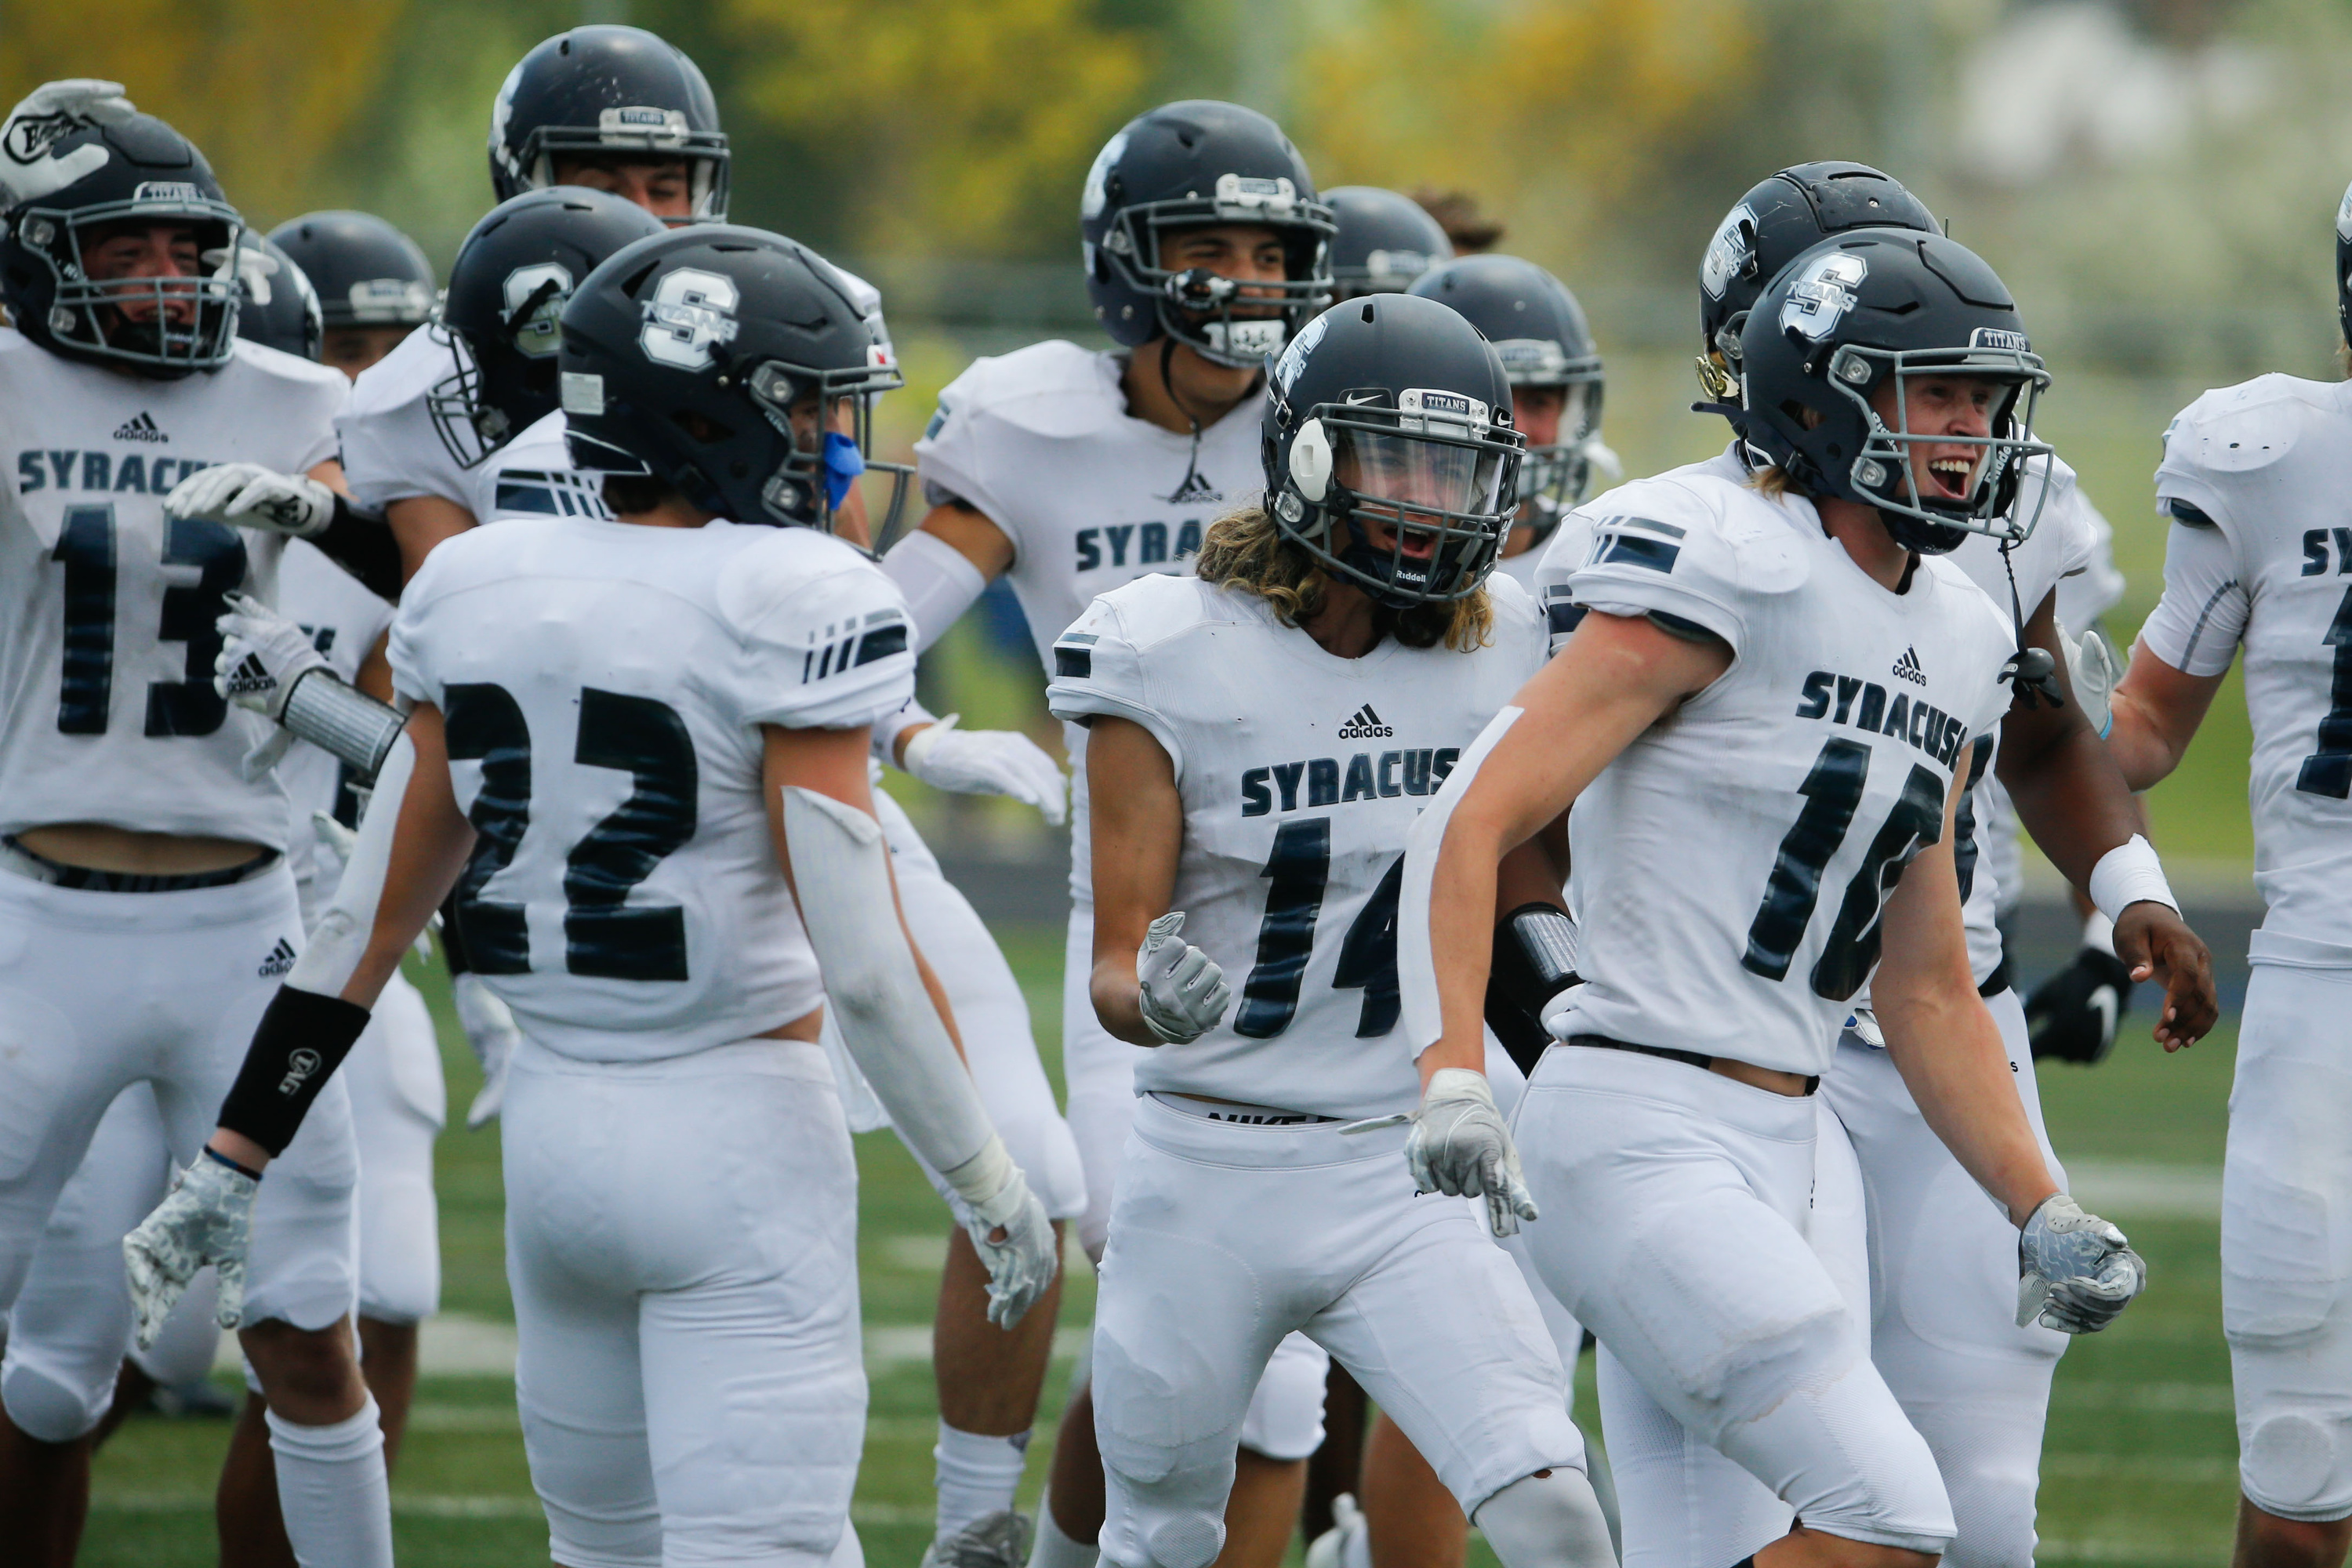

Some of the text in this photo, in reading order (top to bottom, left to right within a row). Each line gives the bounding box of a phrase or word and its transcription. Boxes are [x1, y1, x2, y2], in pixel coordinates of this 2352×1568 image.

[1984, 332, 2027, 351] TITANS
[1427, 395, 1466, 412] TITANS
[114, 430, 169, 443] adidas
[1396, 569, 1427, 583] Riddell
[51, 503, 247, 739] 13
[1893, 664, 1927, 687] adidas
[1338, 724, 1393, 739] adidas
[1241, 747, 1460, 818] SYRACUS
[441, 681, 700, 982] 22
[1740, 734, 1945, 1003] 10
[1233, 808, 1425, 1040] 14
[278, 1054, 318, 1096] TAG
